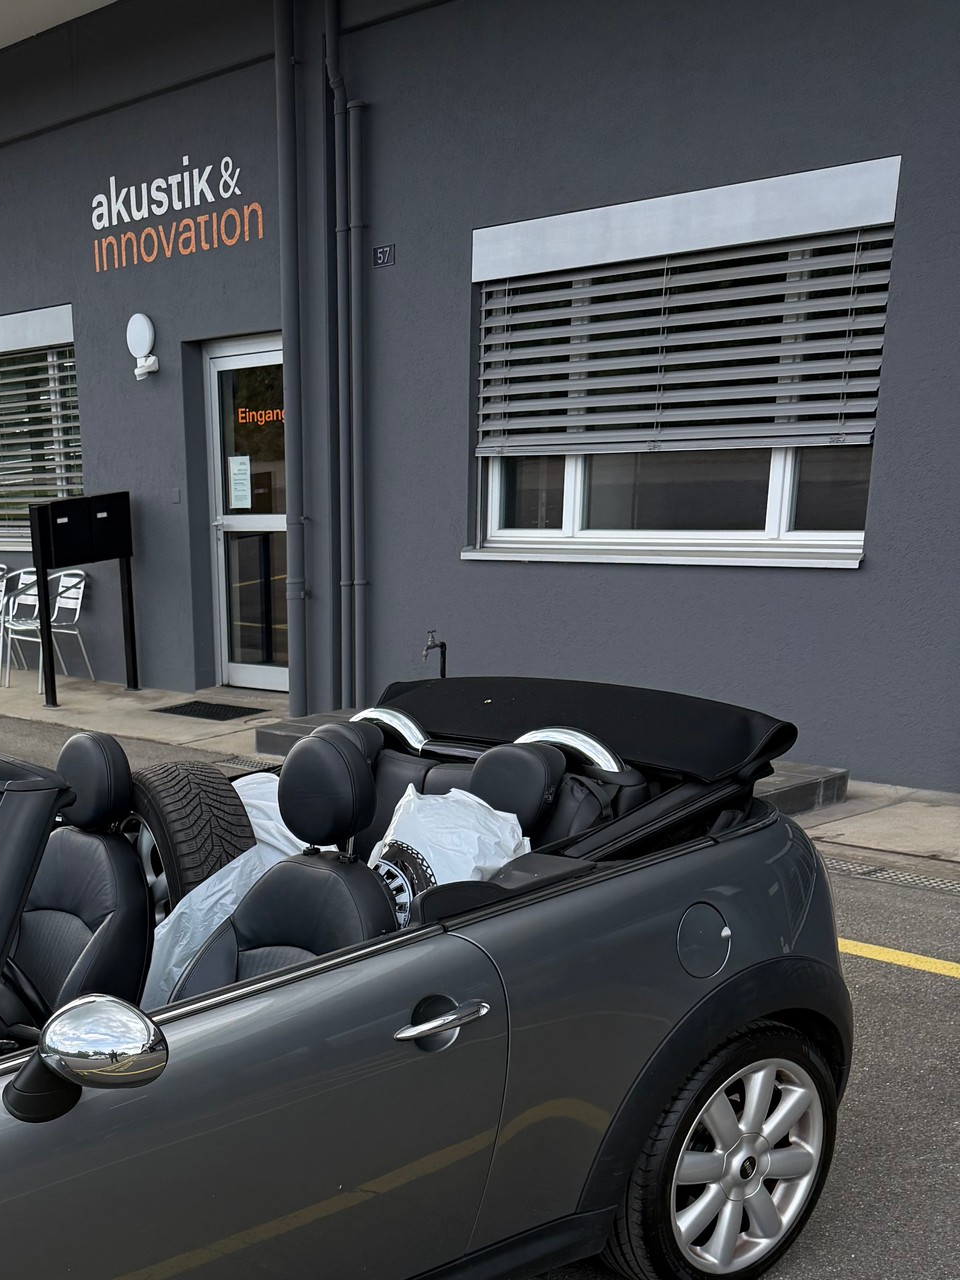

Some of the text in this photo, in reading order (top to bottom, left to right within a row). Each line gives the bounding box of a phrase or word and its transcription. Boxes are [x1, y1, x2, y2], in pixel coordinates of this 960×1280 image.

[91, 155, 242, 231] akustik &
[93, 201, 264, 273] innovation
[377, 247, 390, 264] 57
